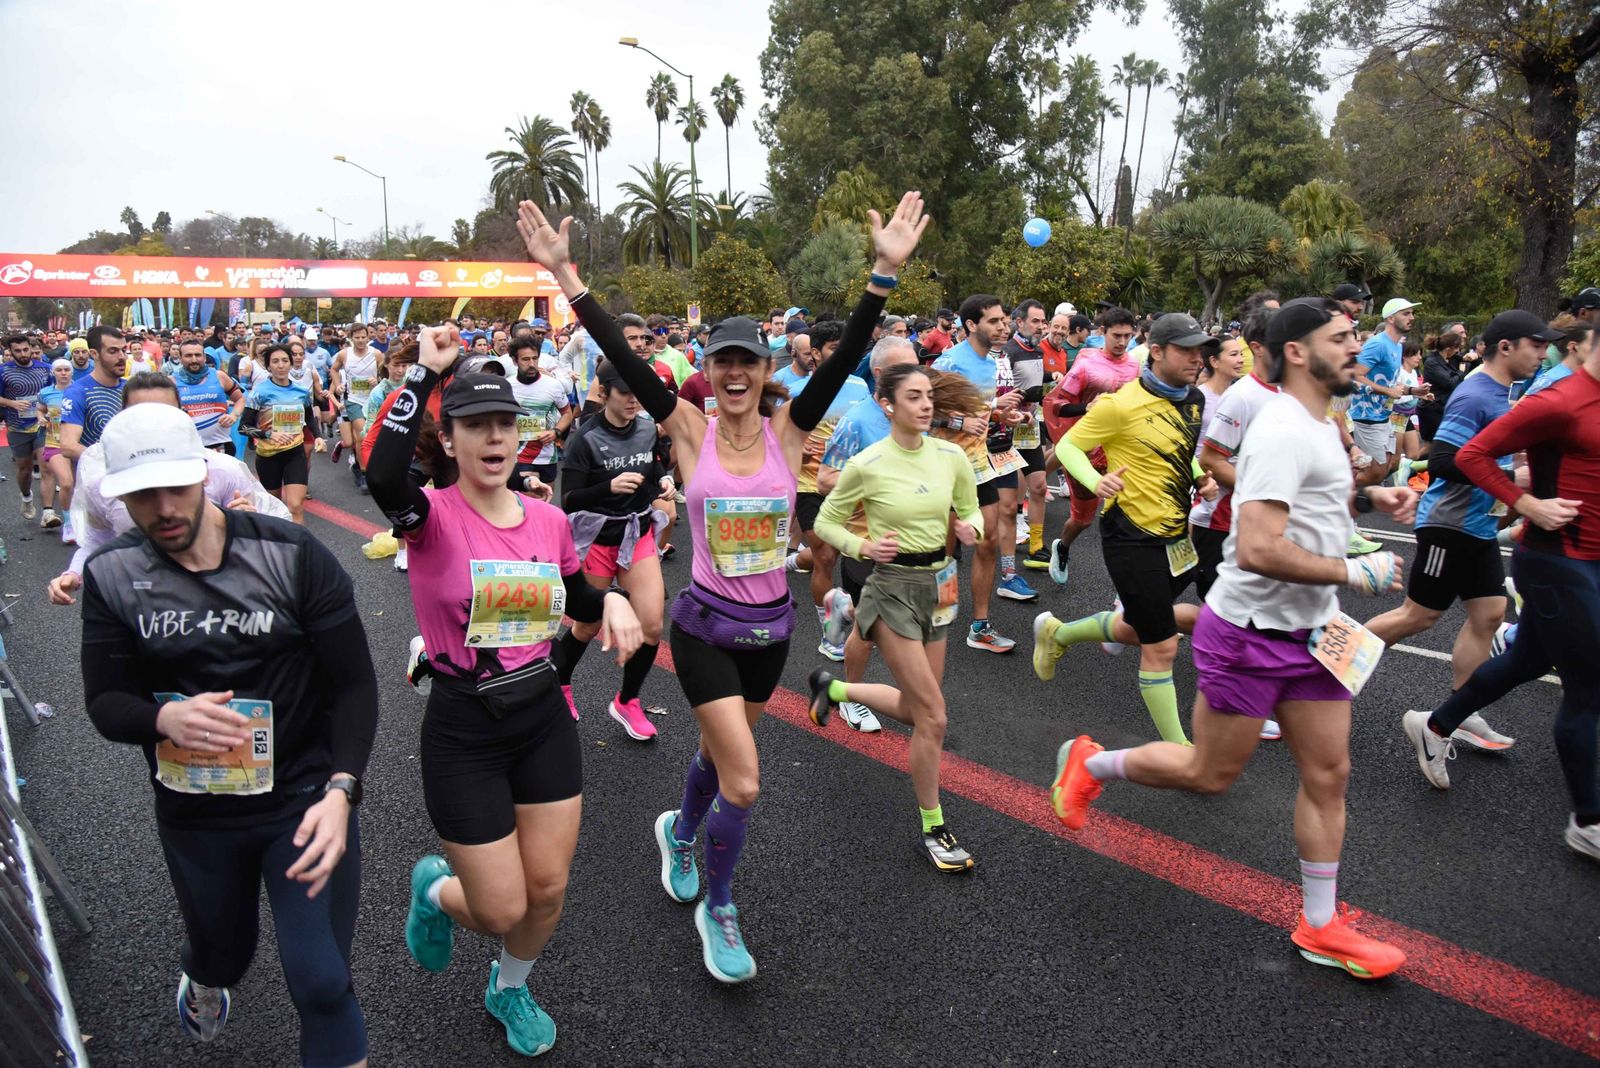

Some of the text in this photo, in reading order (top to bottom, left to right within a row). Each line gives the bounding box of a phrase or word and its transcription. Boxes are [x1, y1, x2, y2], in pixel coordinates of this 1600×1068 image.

[133, 270, 181, 284] HOKA
[371, 272, 410, 285] HOKA
[181, 392, 218, 401] enerplus
[719, 516, 772, 542] 9856
[483, 582, 550, 609] 12431
[1322, 623, 1352, 661] 5564
